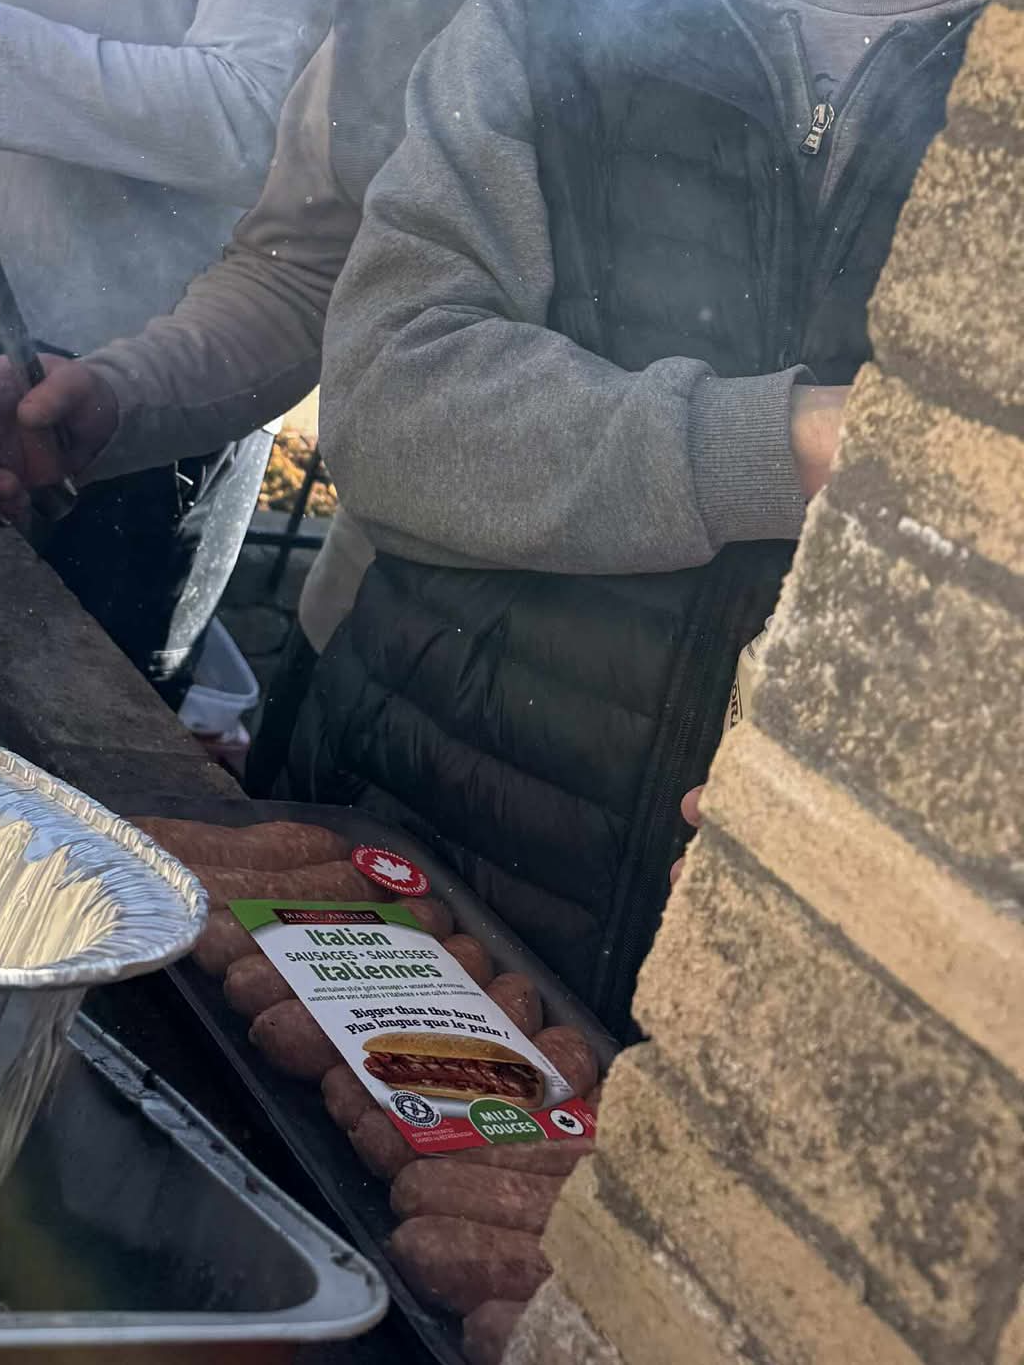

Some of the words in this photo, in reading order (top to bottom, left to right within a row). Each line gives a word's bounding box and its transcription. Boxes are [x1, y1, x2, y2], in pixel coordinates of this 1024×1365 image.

[284, 913, 320, 921] MARC
[328, 913, 376, 921] ANGELO
[305, 928, 392, 946] Italian
[285, 950, 358, 962] SAUSAGES
[366, 949, 439, 960] SAUCISSES
[309, 961, 443, 982] Italiennes
[349, 1007, 395, 1018] Bigger
[395, 1005, 428, 1016] than
[428, 1006, 454, 1017] the
[451, 1009, 487, 1023] bun!
[345, 1023, 377, 1035] Plus
[373, 1018, 422, 1029] longue
[422, 1019, 449, 1029] que
[450, 1019, 466, 1029] le
[467, 1023, 503, 1037] pain
[479, 1109, 518, 1122] MILD
[482, 1121, 537, 1135] DOUCES
